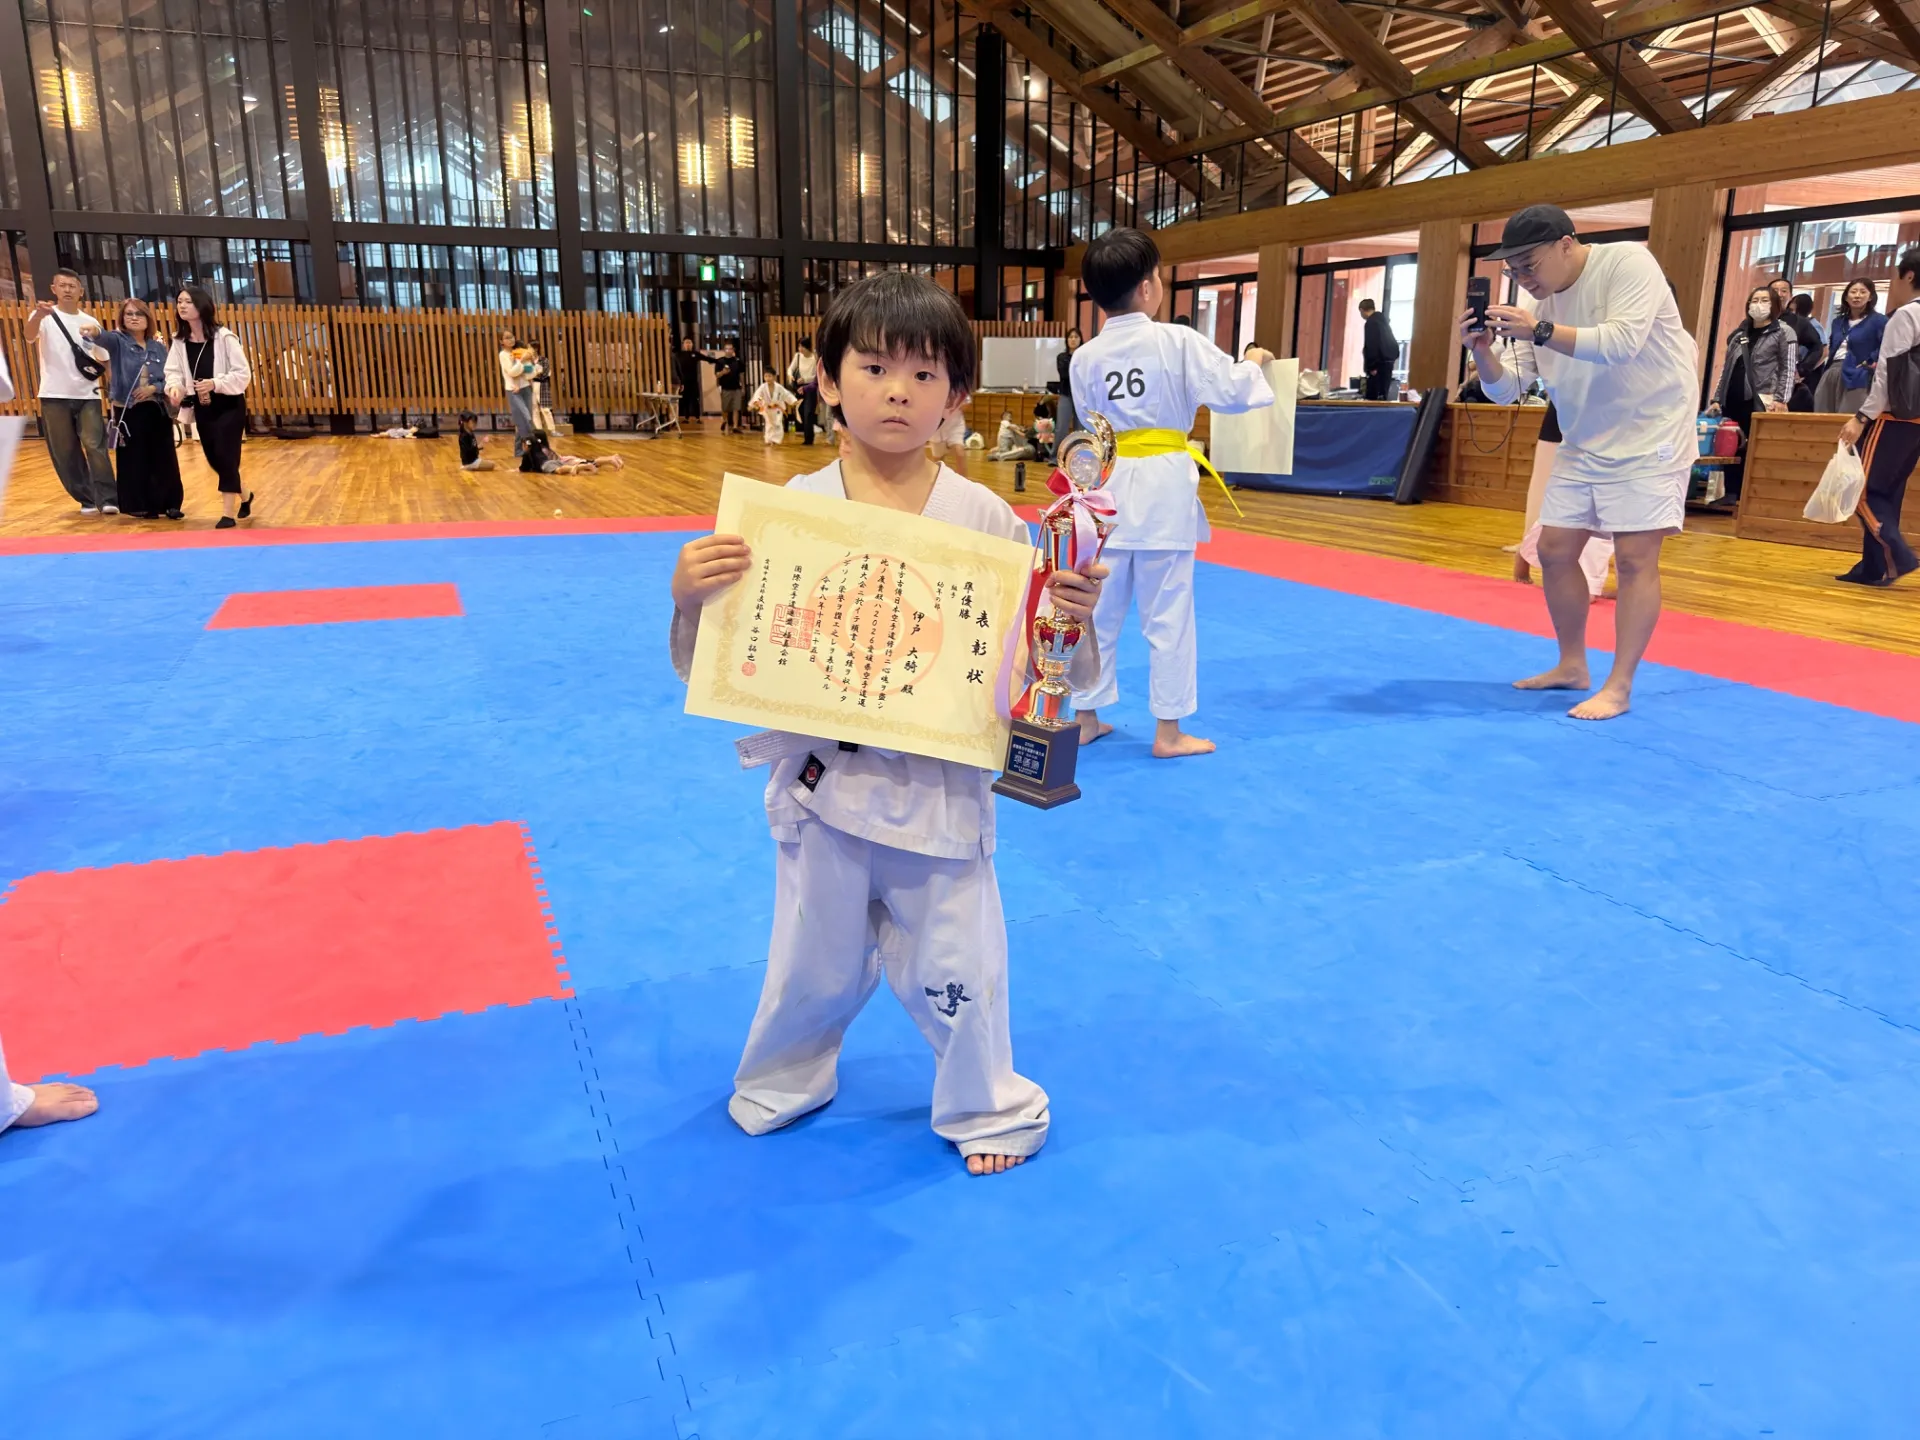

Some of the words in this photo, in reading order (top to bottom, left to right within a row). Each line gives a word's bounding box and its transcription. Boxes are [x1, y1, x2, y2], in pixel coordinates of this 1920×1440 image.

[1105, 368, 1146, 401] 26
[958, 581, 974, 620] 準優勝
